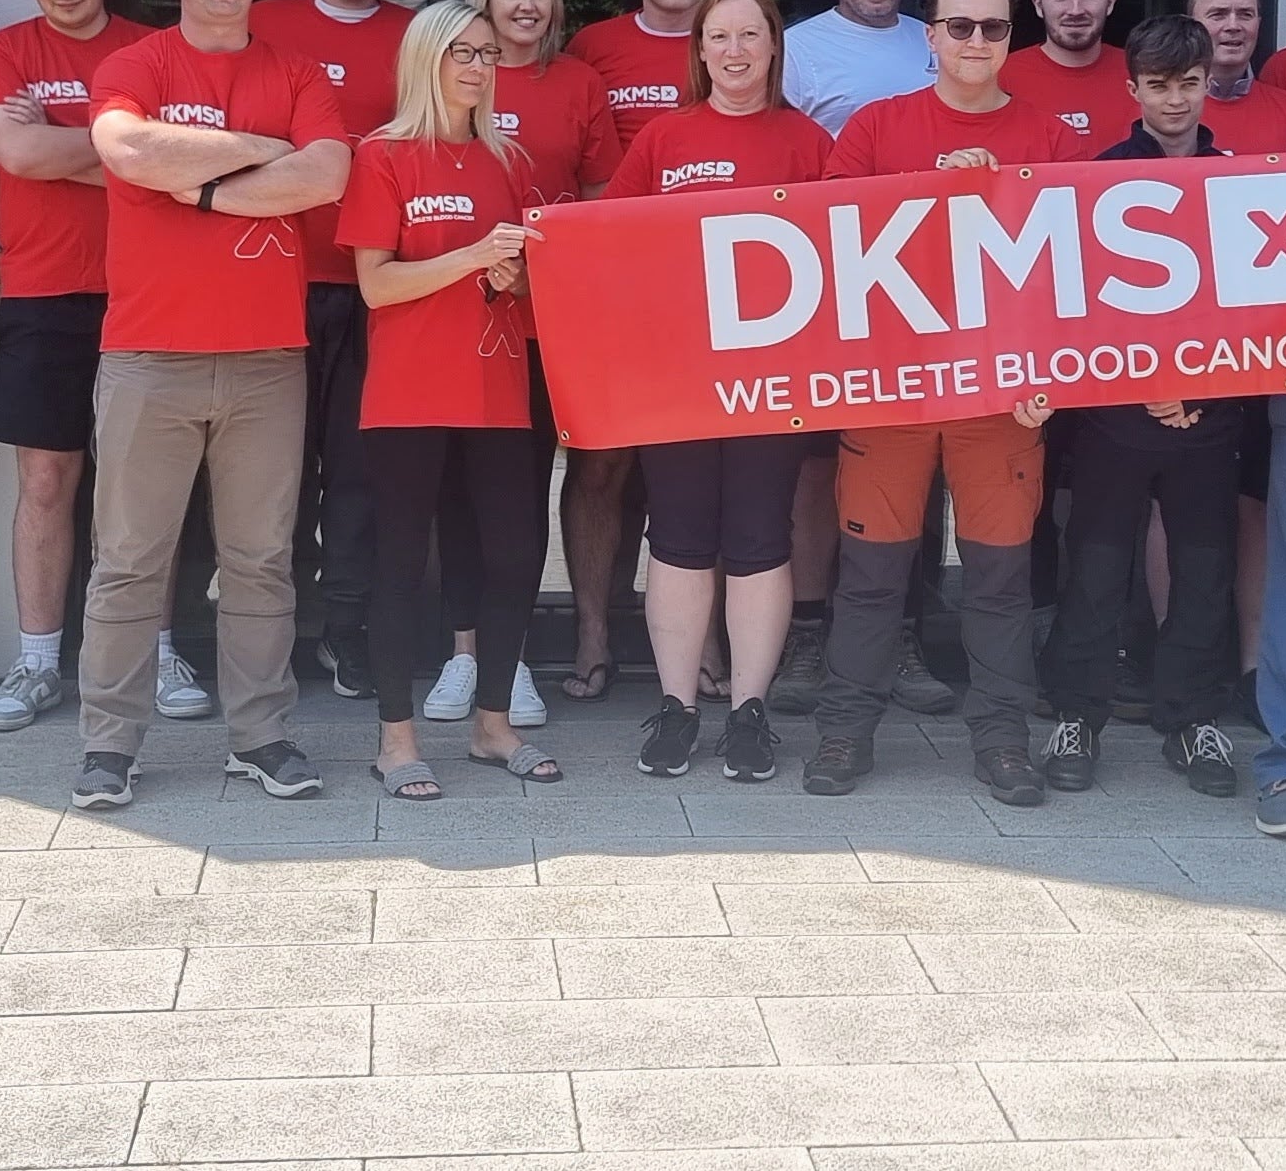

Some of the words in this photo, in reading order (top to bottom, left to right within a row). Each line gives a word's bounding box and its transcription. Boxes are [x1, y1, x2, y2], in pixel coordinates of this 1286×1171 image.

[26, 81, 75, 99] KMS
[607, 86, 660, 105] DKMS
[661, 162, 716, 186] DKMS
[700, 179, 1202, 351] DKMS
[715, 375, 793, 415] WE
[809, 358, 981, 408] DELETE
[995, 342, 1159, 390] BLOOD
